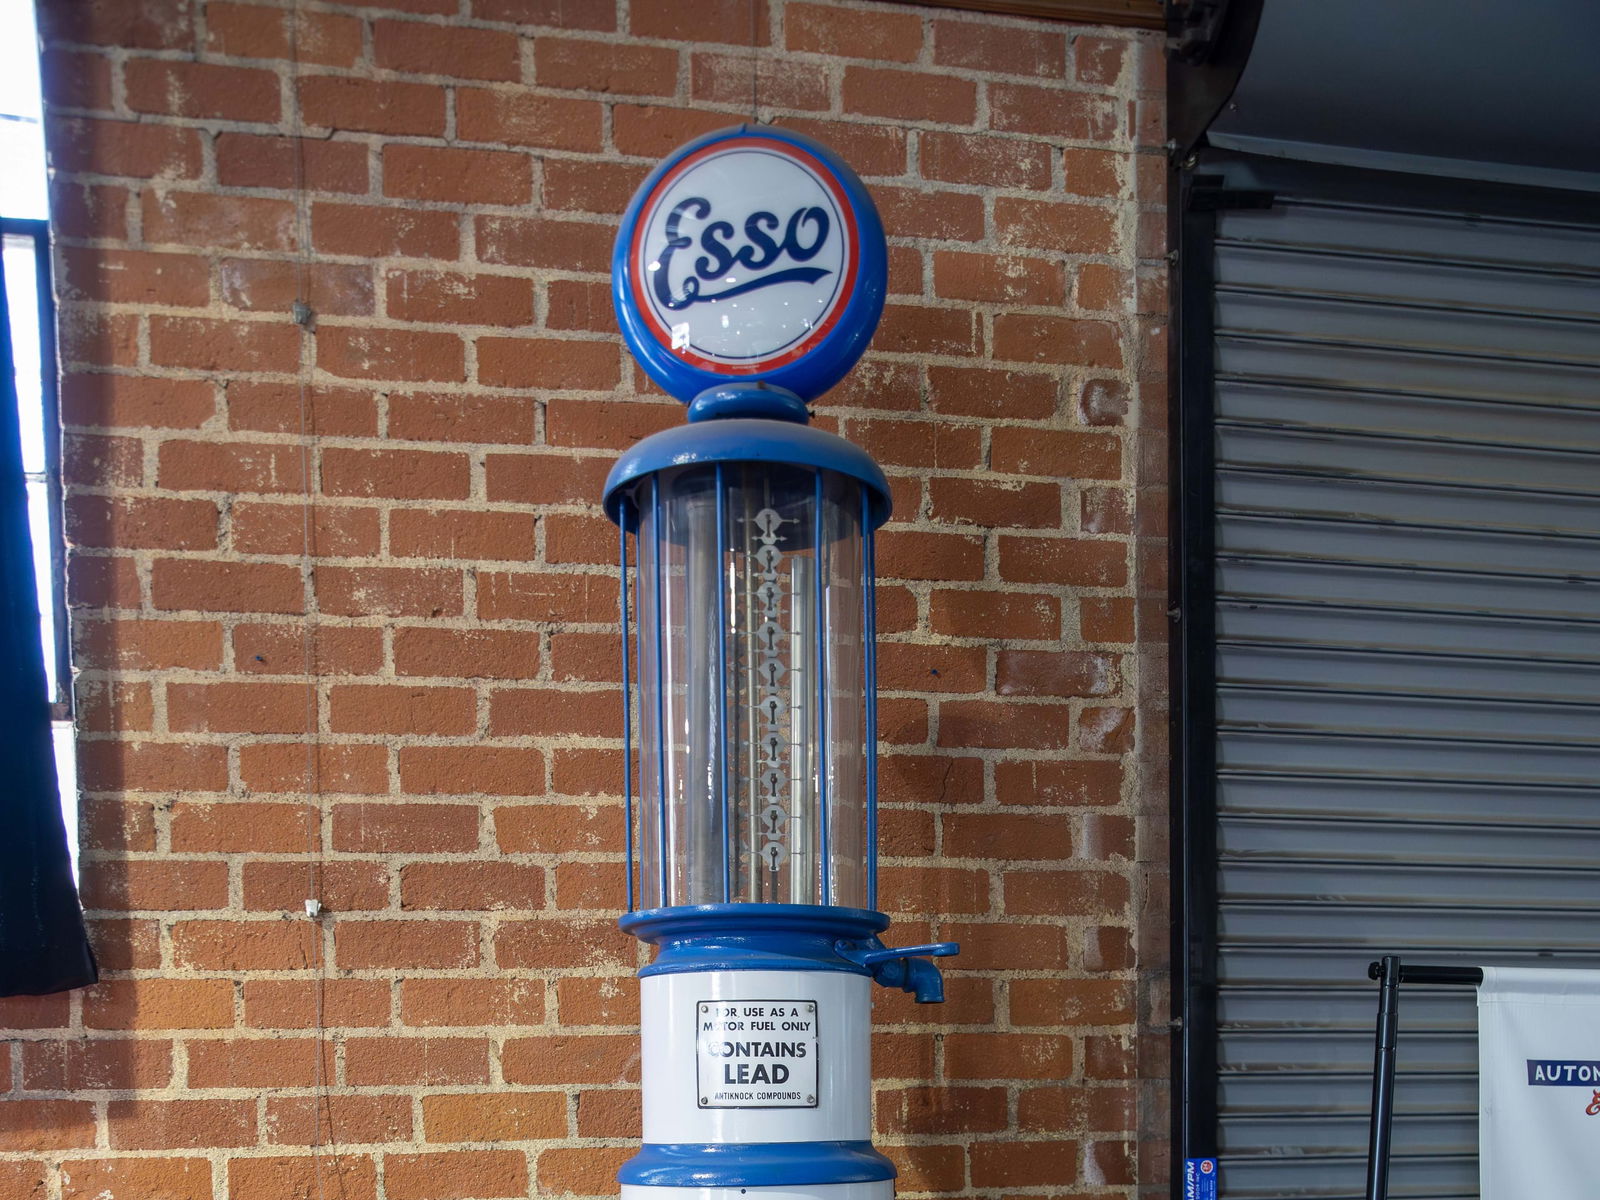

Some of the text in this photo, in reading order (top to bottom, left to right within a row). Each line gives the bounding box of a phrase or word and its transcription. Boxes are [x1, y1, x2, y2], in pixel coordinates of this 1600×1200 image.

[653, 197, 832, 311] Esso
[743, 1007, 764, 1017] USE
[770, 1007, 785, 1017] AS
[790, 1007, 799, 1017] A
[703, 1021, 811, 1032] MTOR FUEL ONLY
[724, 1063, 790, 1085] LEAD
[714, 1091, 802, 1101] ANTIKNOCK COMPOUNDS
